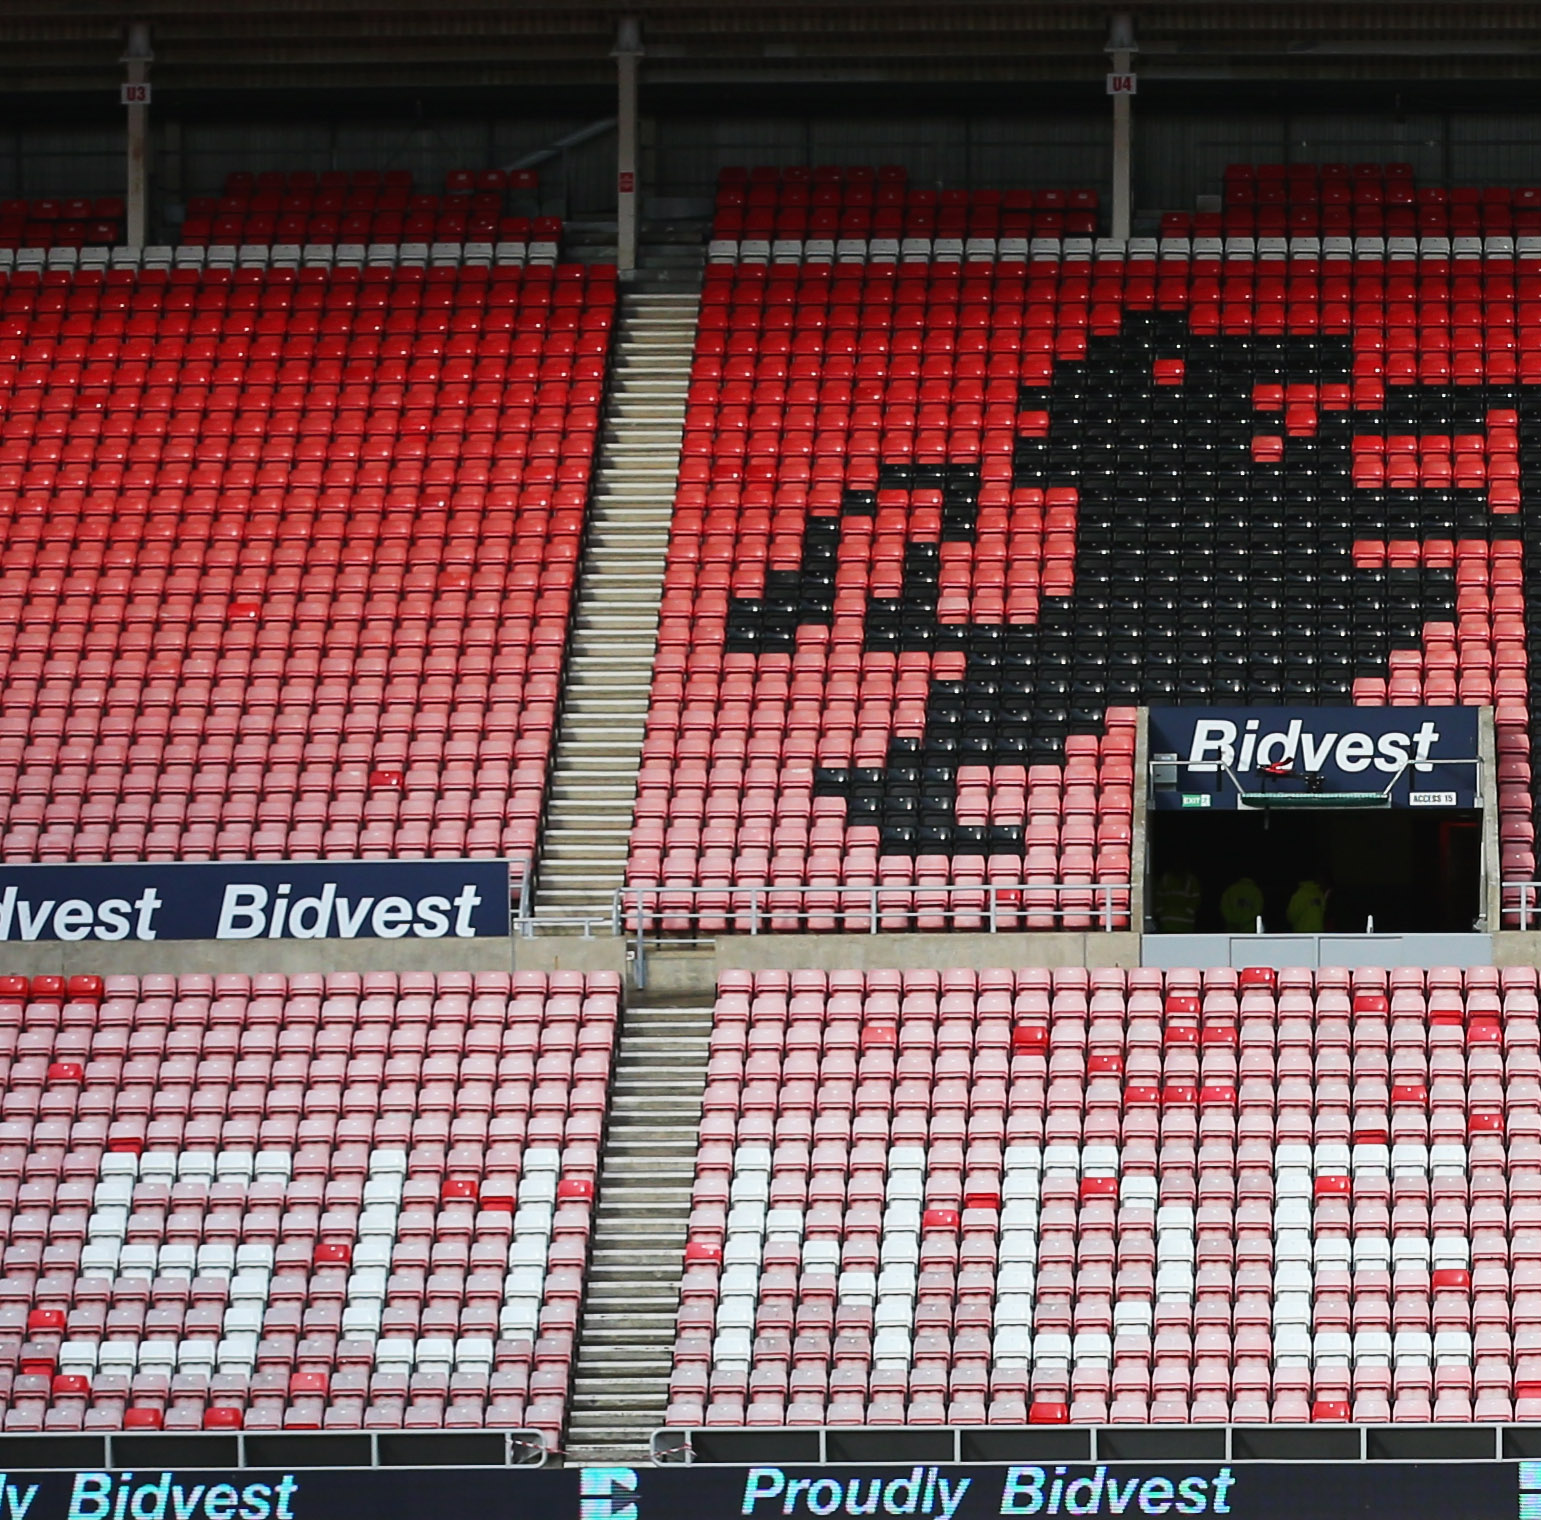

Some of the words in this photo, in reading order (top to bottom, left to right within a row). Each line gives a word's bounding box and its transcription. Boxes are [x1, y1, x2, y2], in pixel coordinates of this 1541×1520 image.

[126, 86, 146, 101] U3
[1112, 76, 1132, 91] U4
[1188, 719, 1440, 772] Bidvest
[217, 884, 481, 940] Bidvest
[68, 1472, 298, 1520] Bidvest
[1000, 1466, 1236, 1515] Bidvest
